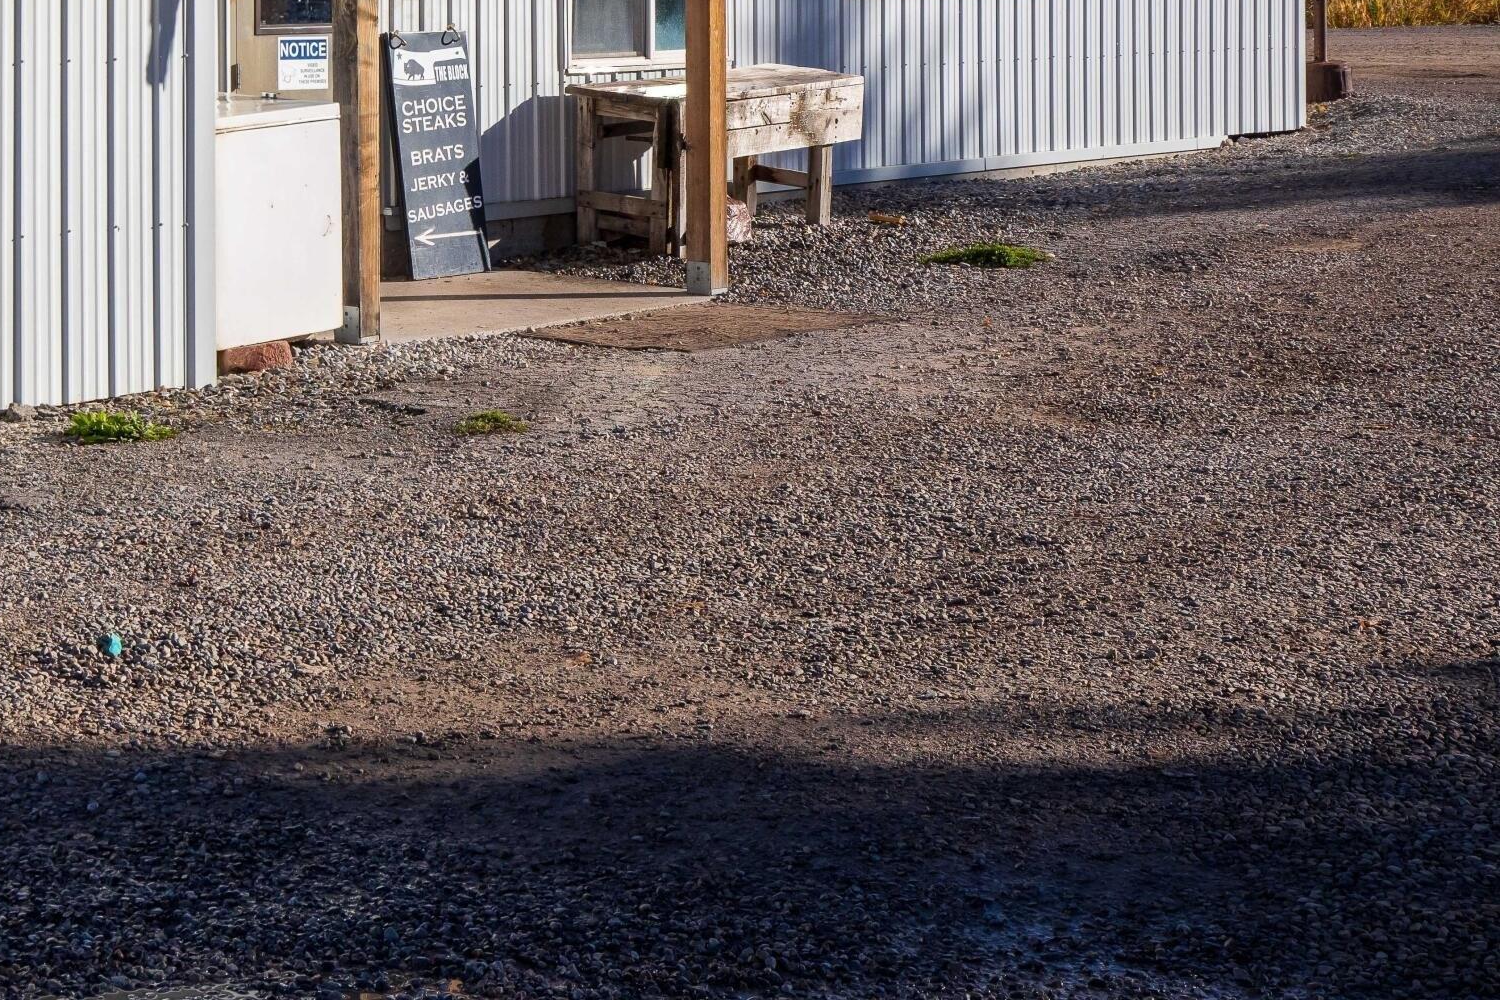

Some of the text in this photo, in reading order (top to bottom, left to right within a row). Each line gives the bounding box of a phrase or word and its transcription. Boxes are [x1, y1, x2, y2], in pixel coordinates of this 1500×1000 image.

[280, 42, 327, 57] NOTICE
[434, 63, 469, 83] THE BLOCK
[402, 94, 467, 117] CHOICE
[402, 111, 468, 134] STEAKS
[410, 144, 465, 167] BRATS
[410, 170, 470, 193] JERKY &
[407, 195, 483, 224] SAUSAGES
